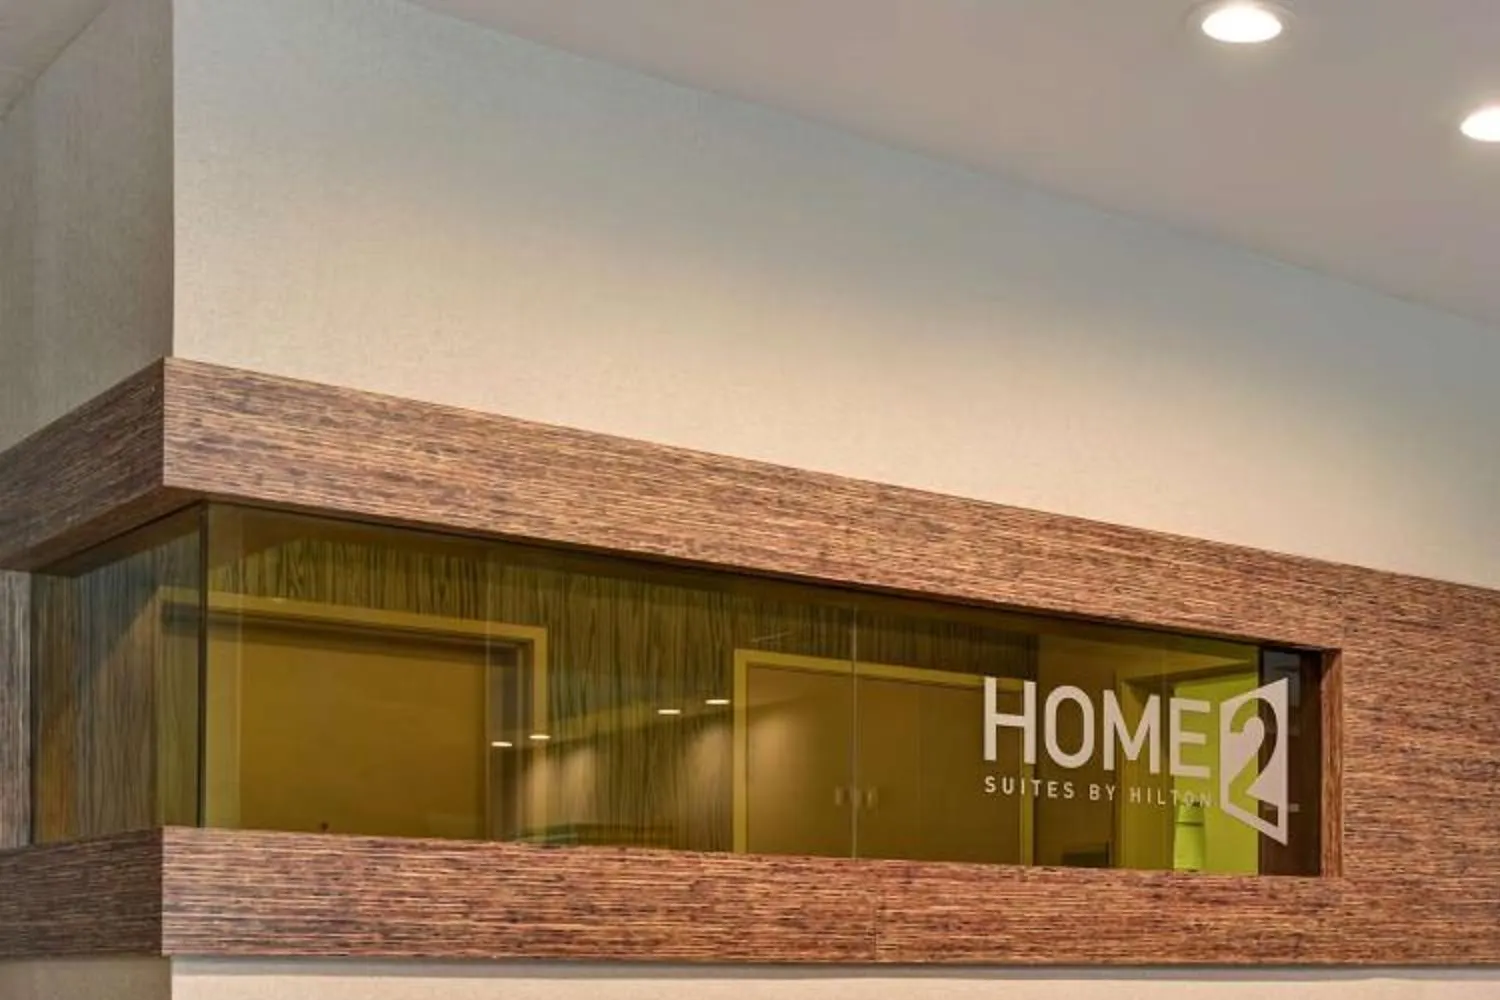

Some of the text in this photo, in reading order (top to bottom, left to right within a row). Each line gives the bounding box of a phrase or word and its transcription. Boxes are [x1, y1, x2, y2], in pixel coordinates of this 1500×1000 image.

[984, 775, 1214, 808] SUITES BY HILTON
